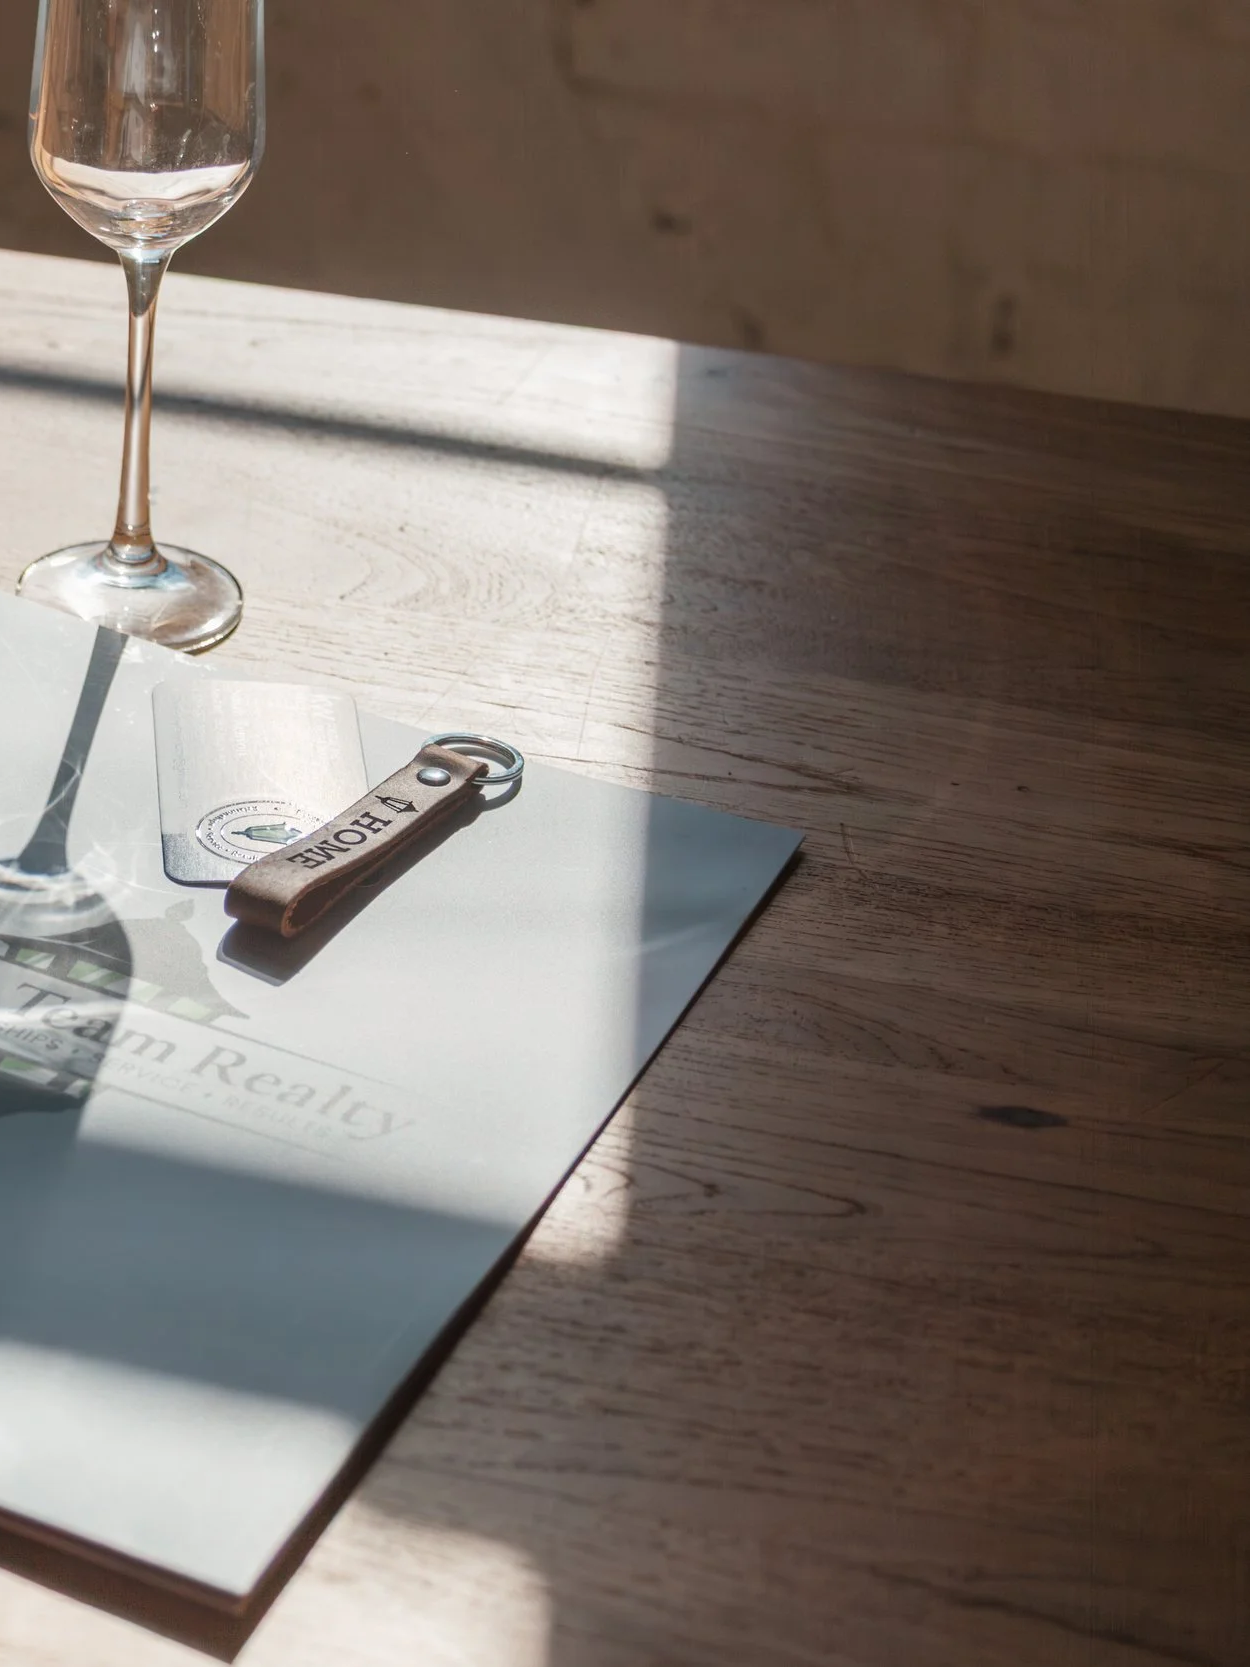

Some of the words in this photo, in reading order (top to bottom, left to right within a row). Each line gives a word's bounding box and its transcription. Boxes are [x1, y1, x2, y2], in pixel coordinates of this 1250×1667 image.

[286, 811, 393, 870] HOME
[15, 983, 177, 1064] Team
[190, 1045, 417, 1141] Realty
[90, 1052, 193, 1093] SERVICE
[221, 1095, 333, 1138] RESULTS
